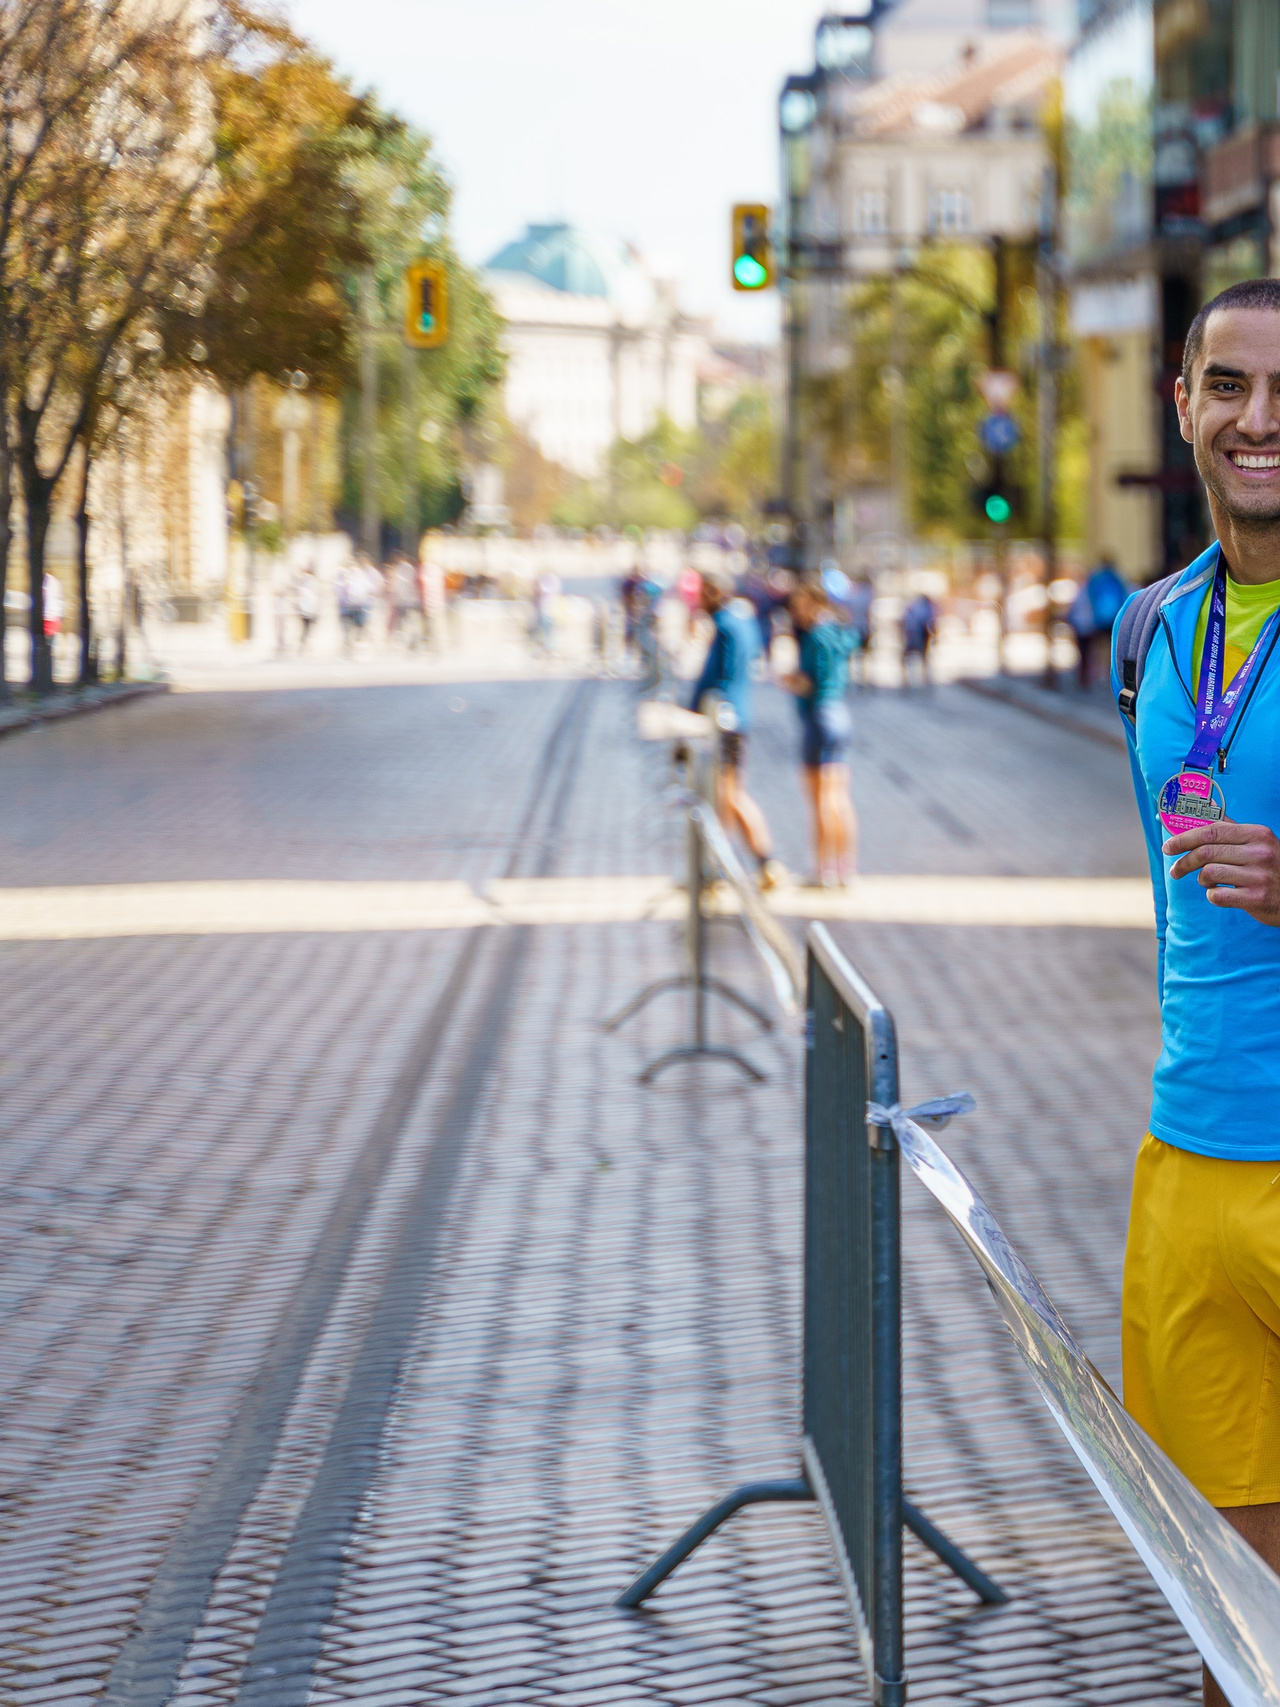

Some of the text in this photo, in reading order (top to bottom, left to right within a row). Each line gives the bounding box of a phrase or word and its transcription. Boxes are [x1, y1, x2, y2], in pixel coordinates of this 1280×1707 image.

[1211, 643, 1219, 659] SOFIA
[1209, 658, 1217, 673] HALF
[1206, 671, 1216, 700] MARATHON
[1204, 698, 1213, 715] 21KM
[1182, 779, 1207, 791] 2023
